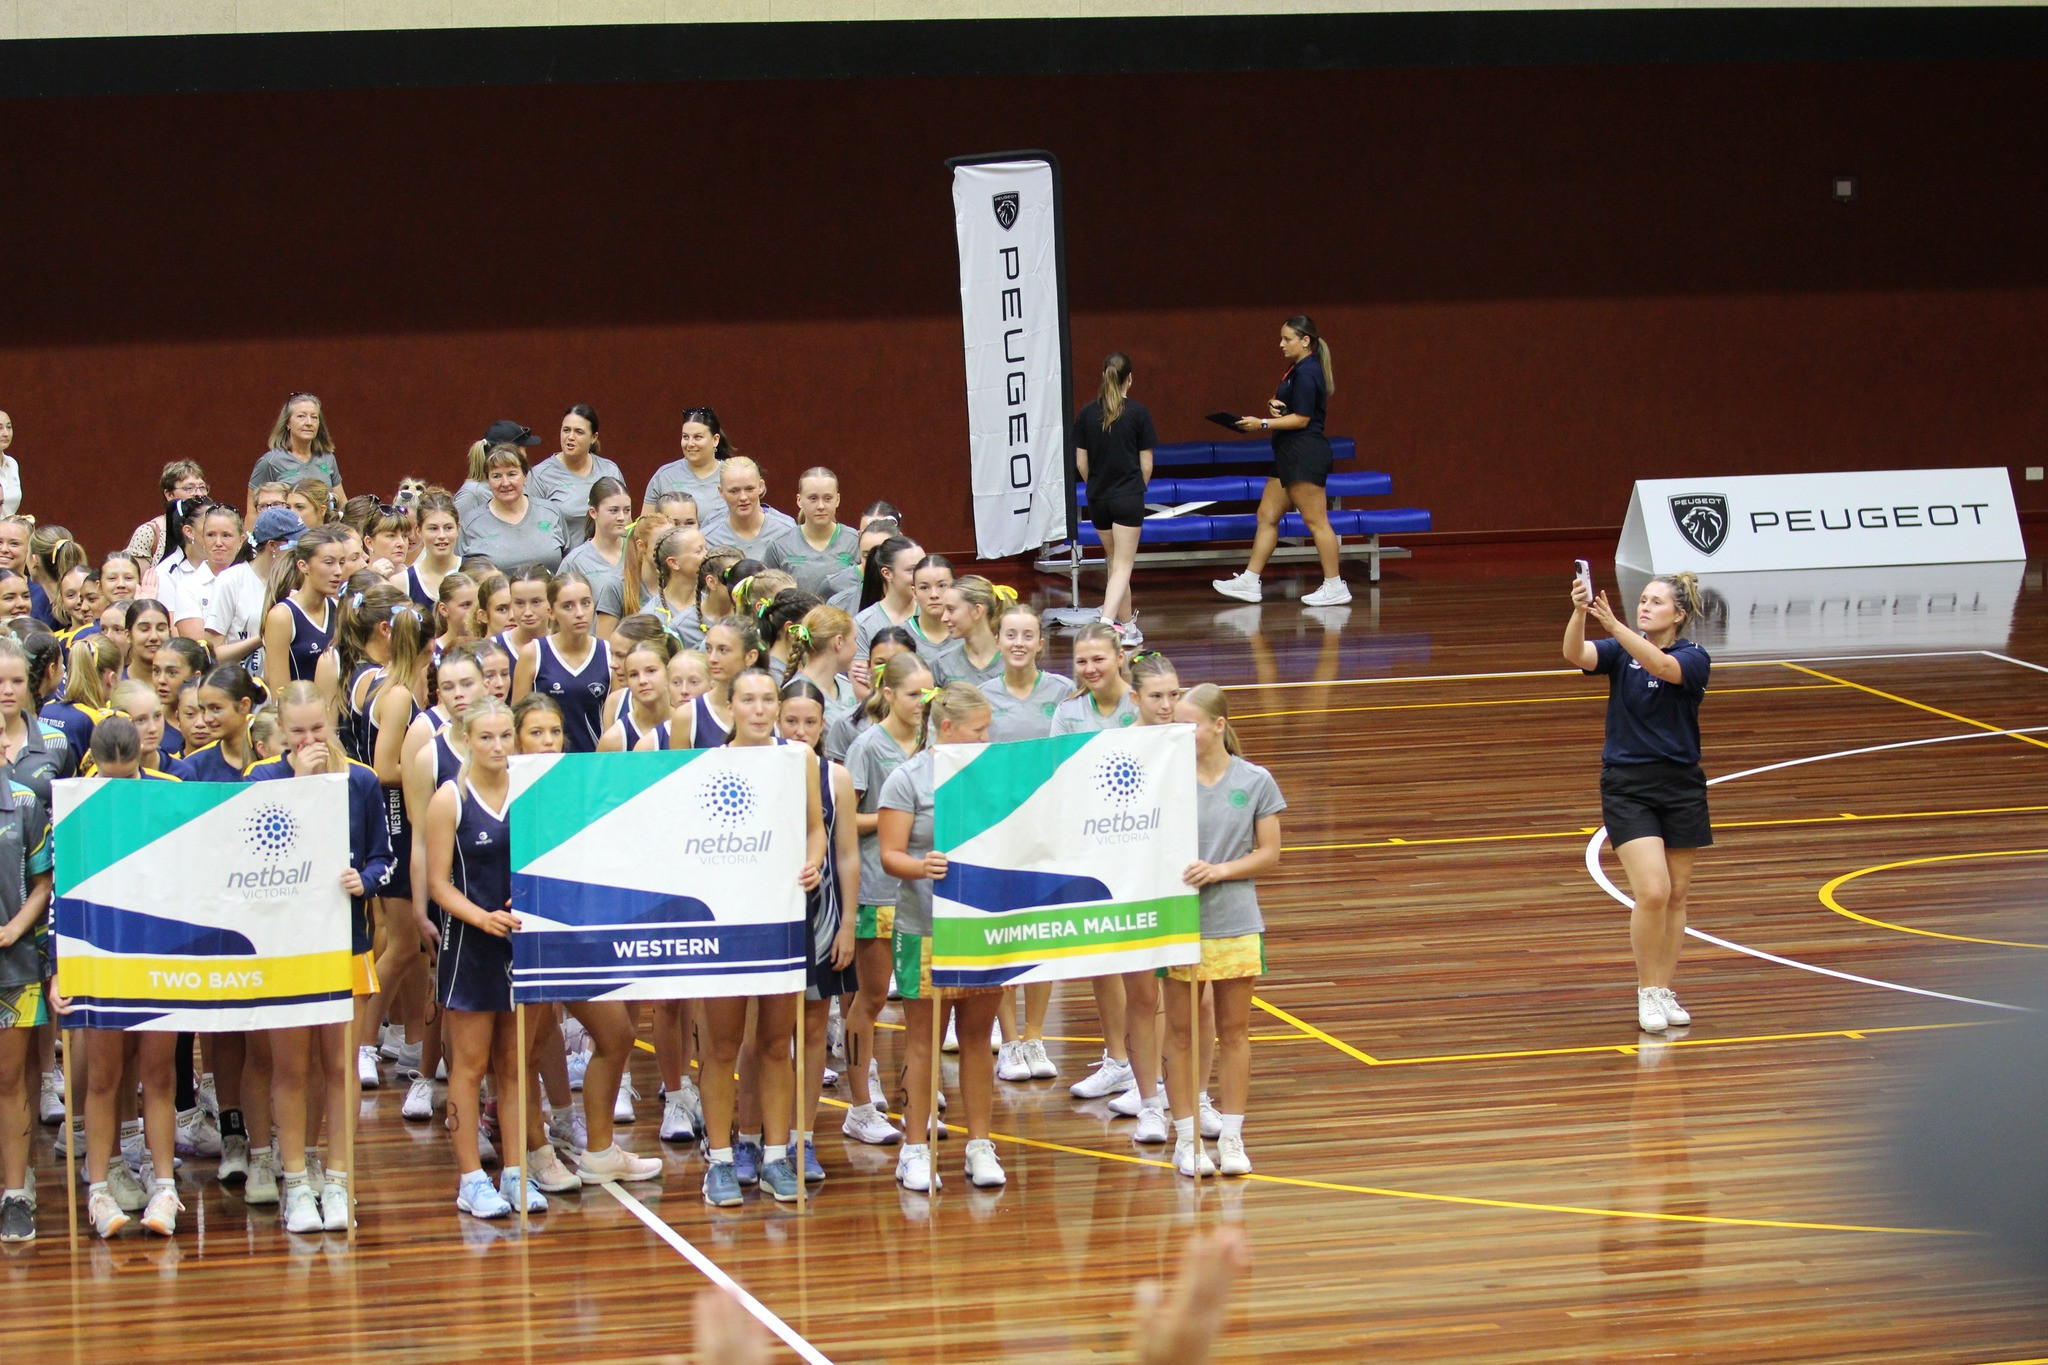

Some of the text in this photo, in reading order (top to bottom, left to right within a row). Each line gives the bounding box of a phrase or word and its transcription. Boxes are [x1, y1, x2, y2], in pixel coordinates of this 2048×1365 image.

[999, 246, 1032, 524] PEUGEOT
[1674, 497, 1722, 506] PEUGEOT
[1750, 503, 1989, 533] PEUGEOT
[389, 789, 402, 835] WESTERN
[1083, 807, 1161, 836] netball
[685, 830, 773, 854] netball
[1096, 832, 1150, 845] VICTORIA
[699, 854, 758, 865] VICTORIA
[227, 860, 313, 889] netball
[242, 886, 299, 900] VICTORIA
[984, 910, 1158, 946] WIMMERA MALLEE
[613, 937, 720, 959] WESTERN
[148, 969, 264, 989] TWO BAYS
